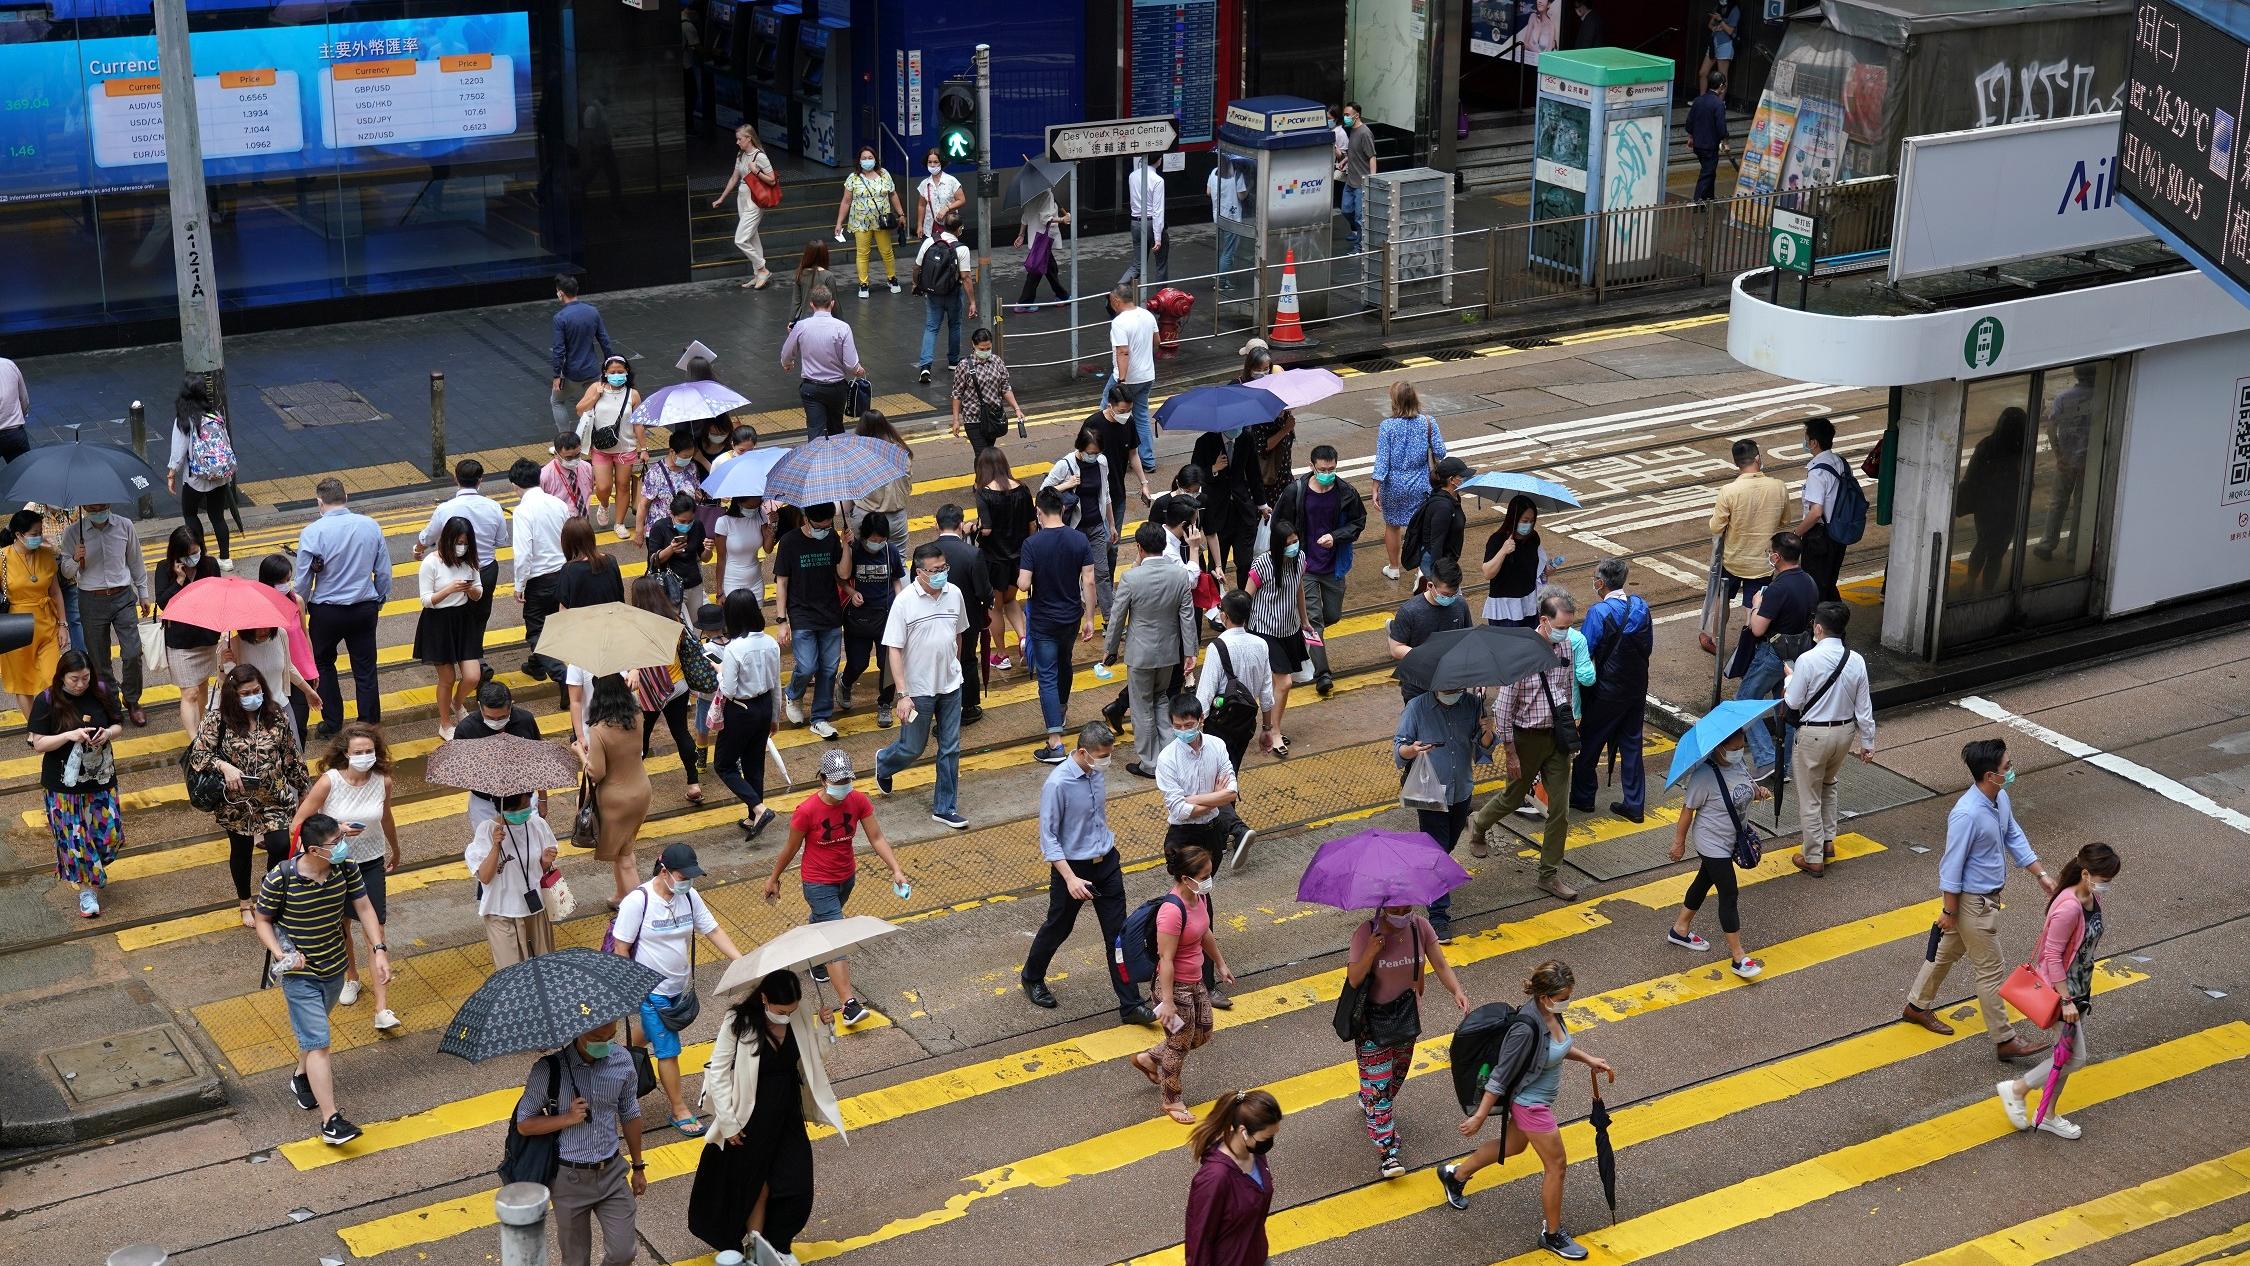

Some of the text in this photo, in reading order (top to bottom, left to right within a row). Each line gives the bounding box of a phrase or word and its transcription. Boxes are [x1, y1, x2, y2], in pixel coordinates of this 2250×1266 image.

[319, 37, 418, 59] 主要外幣匯率
[90, 57, 160, 75] Currenci
[458, 59, 478, 68] Price
[355, 66, 390, 76] Currency
[240, 74, 260, 84] Price
[459, 77, 484, 86] 1.2203
[129, 84, 160, 92] Currenc
[354, 84, 390, 94] GBP/USD
[1634, 86, 1665, 94] PAYPHONE
[239, 92, 268, 102] 0.6565
[459, 92, 485, 102] 7.7502
[128, 102, 162, 110] AUD/US
[356, 99, 392, 110] USD/HKD
[243, 109, 268, 118] 1.3934
[464, 108, 486, 116] 107.61
[2153, 84, 2189, 138] 26-29
[130, 118, 162, 126] USD/CA
[356, 115, 392, 125] USD/JPY
[244, 125, 270, 134] 7.1044
[462, 122, 487, 132] 0.6123
[358, 130, 394, 140] NZD/USD
[1064, 124, 1166, 141] Des Voeux Road Central
[131, 134, 164, 142] USD/CN
[245, 140, 272, 150] 1.0962
[133, 150, 166, 158] EUR/US
[1554, 167, 1568, 176] HGC
[1301, 179, 1323, 188] PCCW
[2166, 163, 2204, 220] 80-95
[2230, 202, 2250, 264] 相
[1800, 238, 1810, 246] 27E
